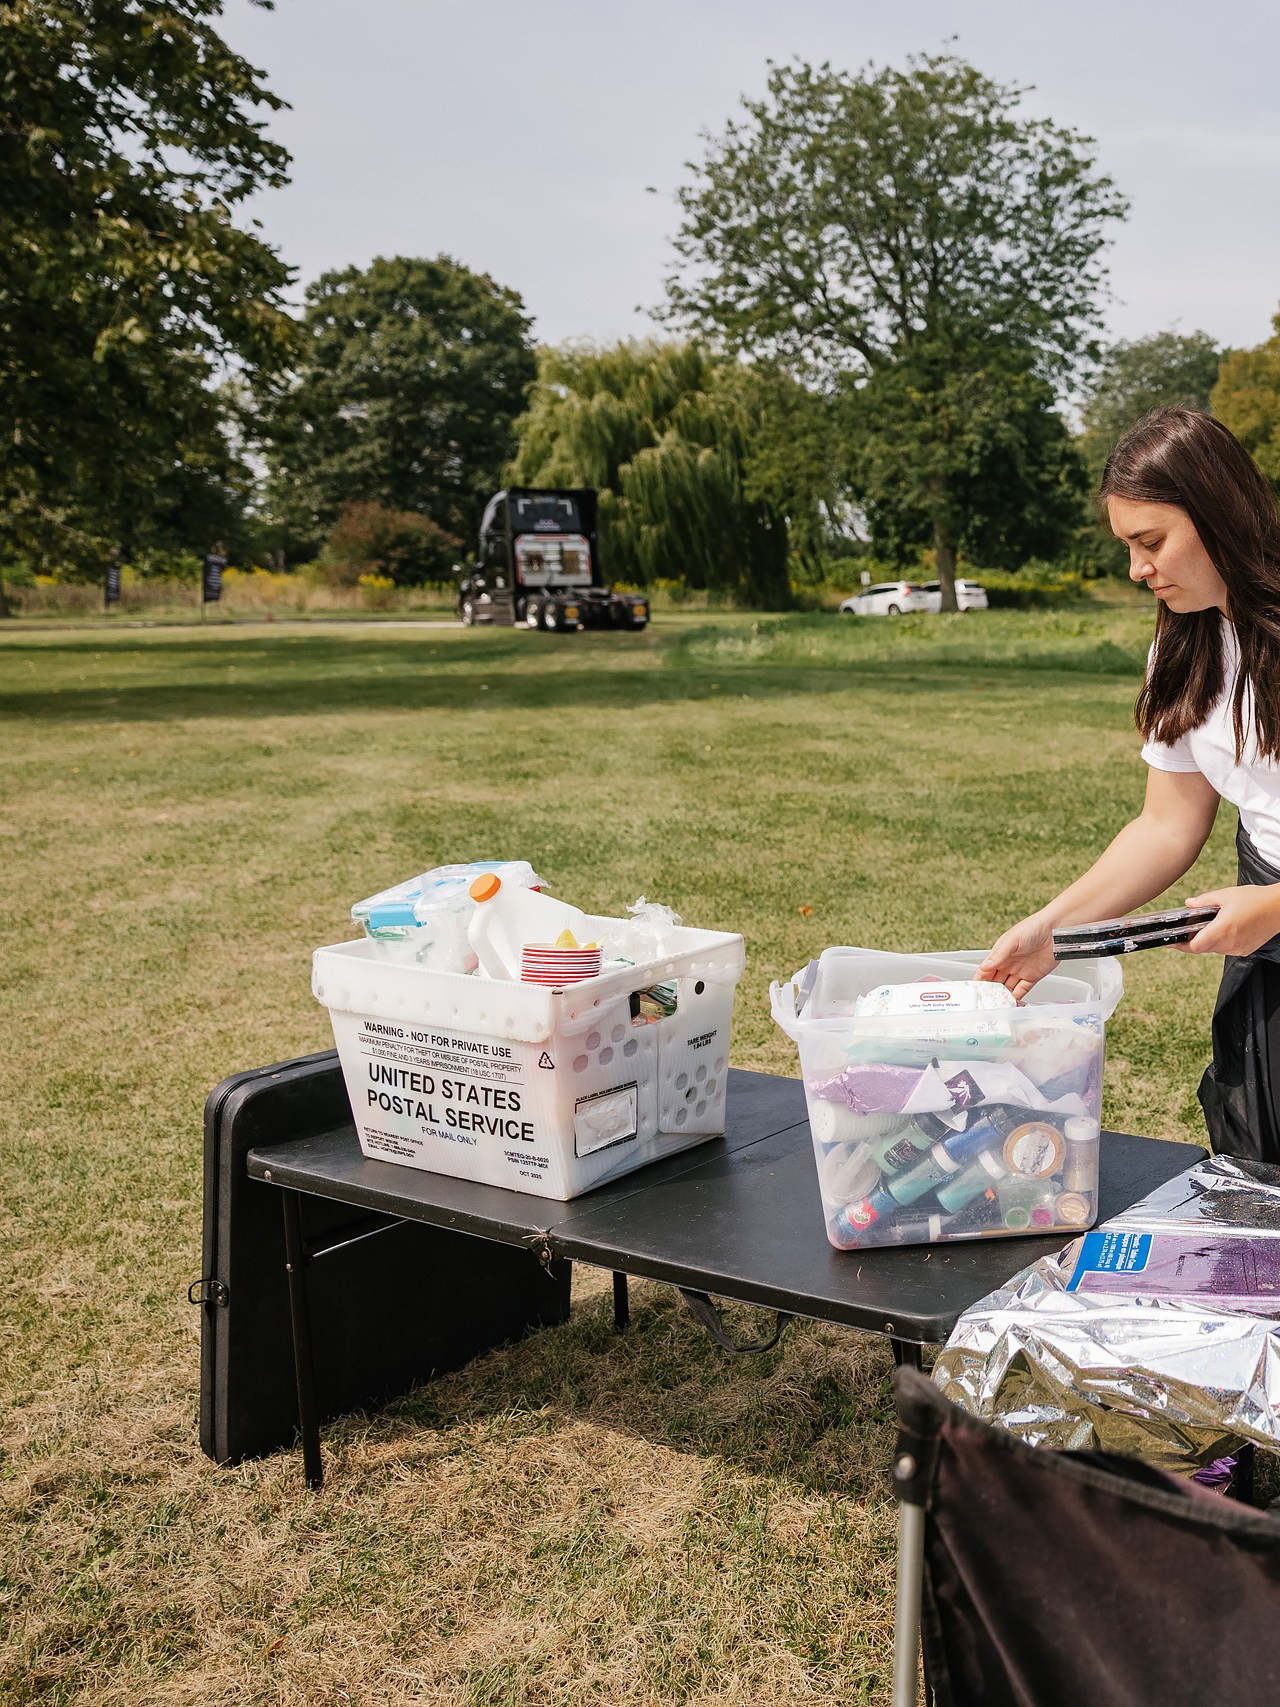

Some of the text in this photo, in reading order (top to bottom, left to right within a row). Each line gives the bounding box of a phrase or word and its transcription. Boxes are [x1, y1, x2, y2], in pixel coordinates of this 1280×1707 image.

[364, 1021, 404, 1038] WARNING
[411, 1031, 429, 1043] NOT
[431, 1035, 450, 1047] FOR
[452, 1039, 489, 1054] PRIVATE
[492, 1047, 512, 1058] USE
[687, 1030, 717, 1046] TARE WEIGHT
[703, 1038, 712, 1046] LBS
[359, 1036, 381, 1046] MAXIMUM
[382, 1041, 403, 1051] PENALTY
[415, 1048, 431, 1056] THEFT
[441, 1053, 460, 1063] MISUSE
[469, 1059, 490, 1068] POSTAL
[491, 1063, 522, 1073] PROPERTY
[413, 1056, 430, 1065] YEARS
[431, 1061, 470, 1073] IMPRISONMENT
[369, 1062, 521, 1112] UNITED STATES
[368, 1089, 535, 1142] POSTAL SERVICE
[421, 1126, 477, 1146] FOR MAIL ONLY
